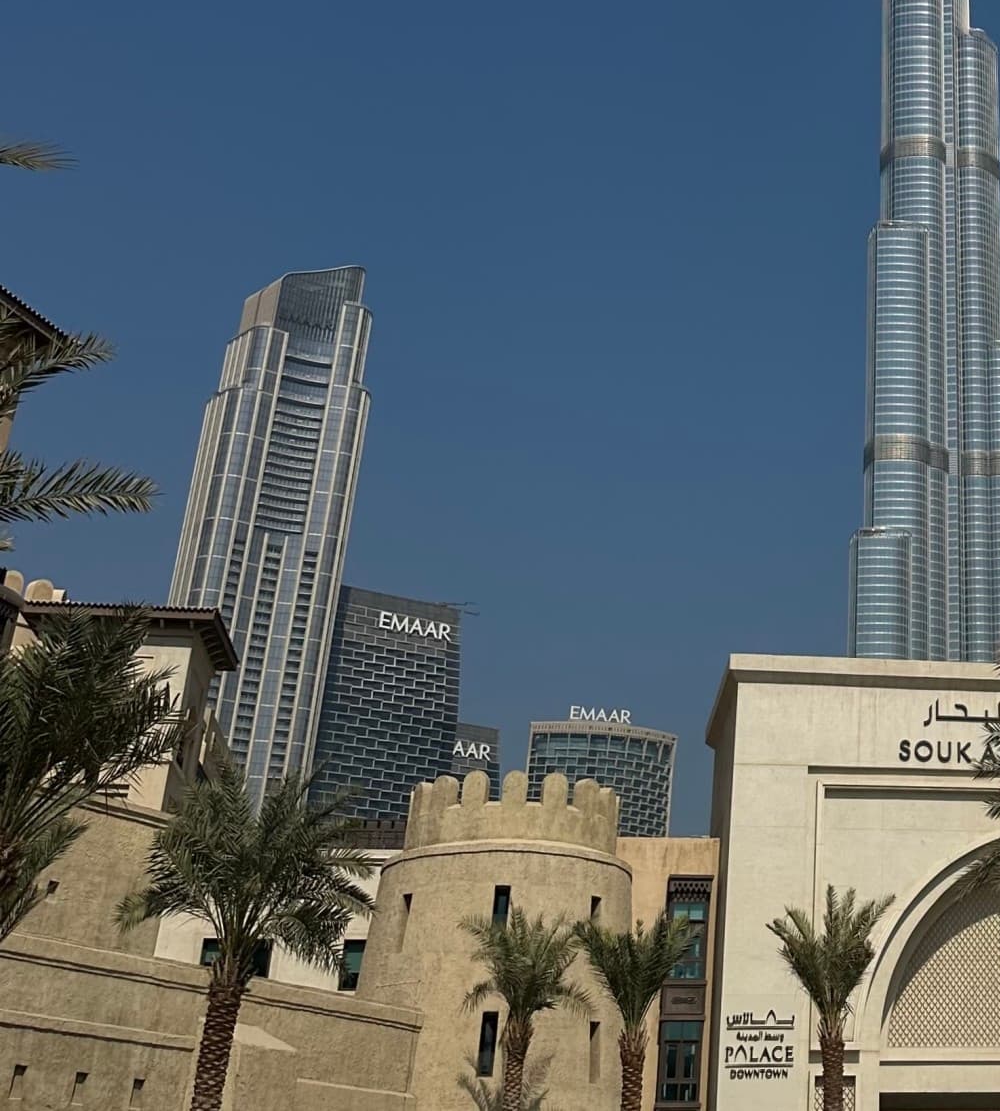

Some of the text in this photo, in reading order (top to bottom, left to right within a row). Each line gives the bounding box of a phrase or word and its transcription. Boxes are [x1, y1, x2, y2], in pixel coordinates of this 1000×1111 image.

[379, 610, 452, 642] EMAAR
[569, 705, 632, 724] EMAAR
[452, 740, 491, 761] AAR
[899, 740, 971, 764] SOUK
[725, 1044, 794, 1063] PALACE
[730, 1069, 788, 1080] DOWNTOWN
